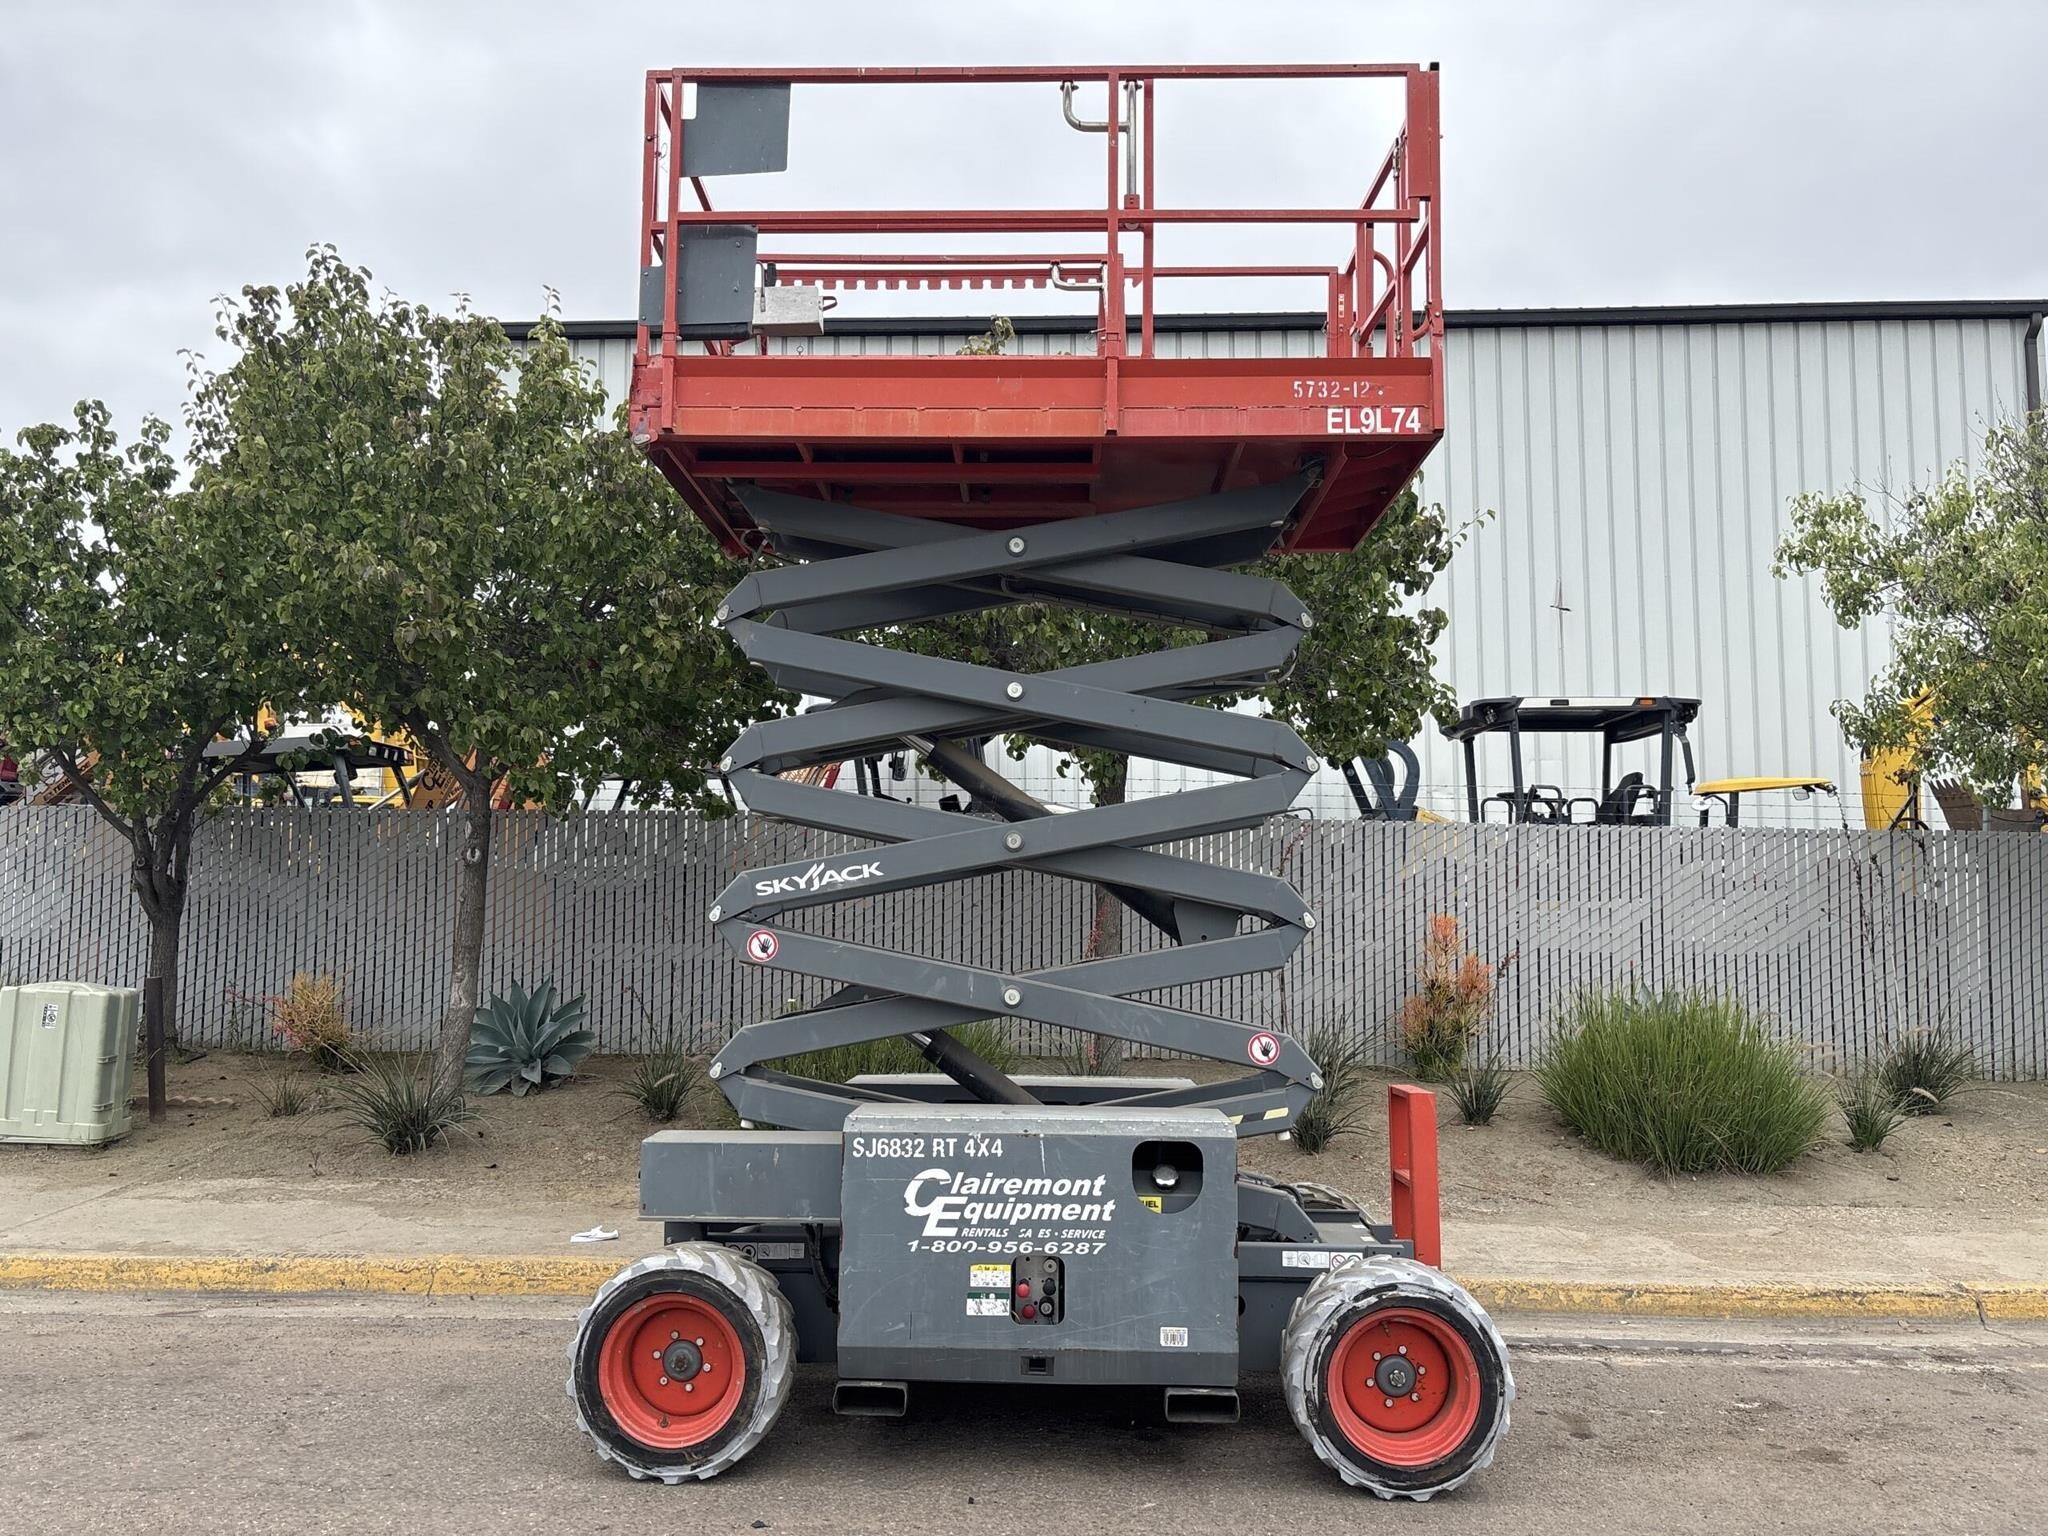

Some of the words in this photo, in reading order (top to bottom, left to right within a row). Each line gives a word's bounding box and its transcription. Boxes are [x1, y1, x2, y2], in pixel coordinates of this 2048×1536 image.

[1327, 407, 1421, 434] EL9L74
[755, 862, 885, 896] SKYJACK
[852, 1137, 925, 1158] SJ6832
[932, 1138, 958, 1158] RT
[964, 1138, 1004, 1158] 4X4
[904, 1168, 1107, 1217] Clairemont
[922, 1196, 1116, 1237] Equipment
[907, 1240, 1107, 1255] 1-800-956-6287
[961, 1228, 1009, 1239] RENTALS
[1061, 1229, 1106, 1240] SERVICE
